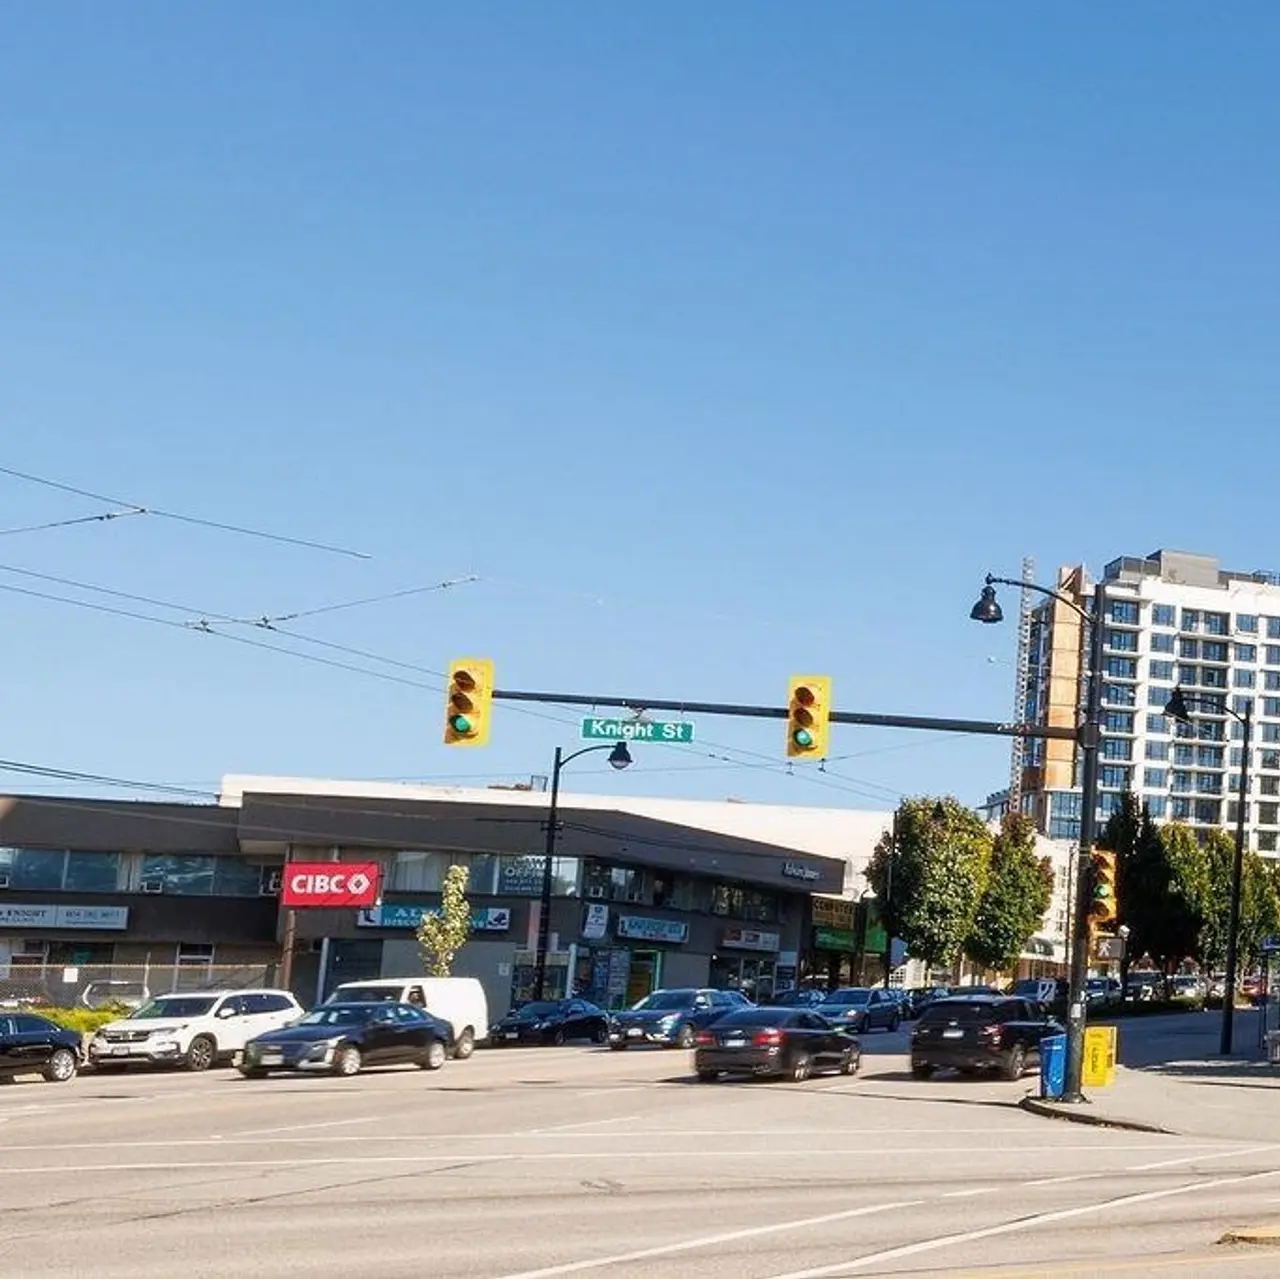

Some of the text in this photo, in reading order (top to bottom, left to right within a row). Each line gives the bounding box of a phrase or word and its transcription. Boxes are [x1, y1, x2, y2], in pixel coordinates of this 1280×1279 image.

[590, 720, 684, 740] Knight St
[291, 874, 345, 894] CIBC
